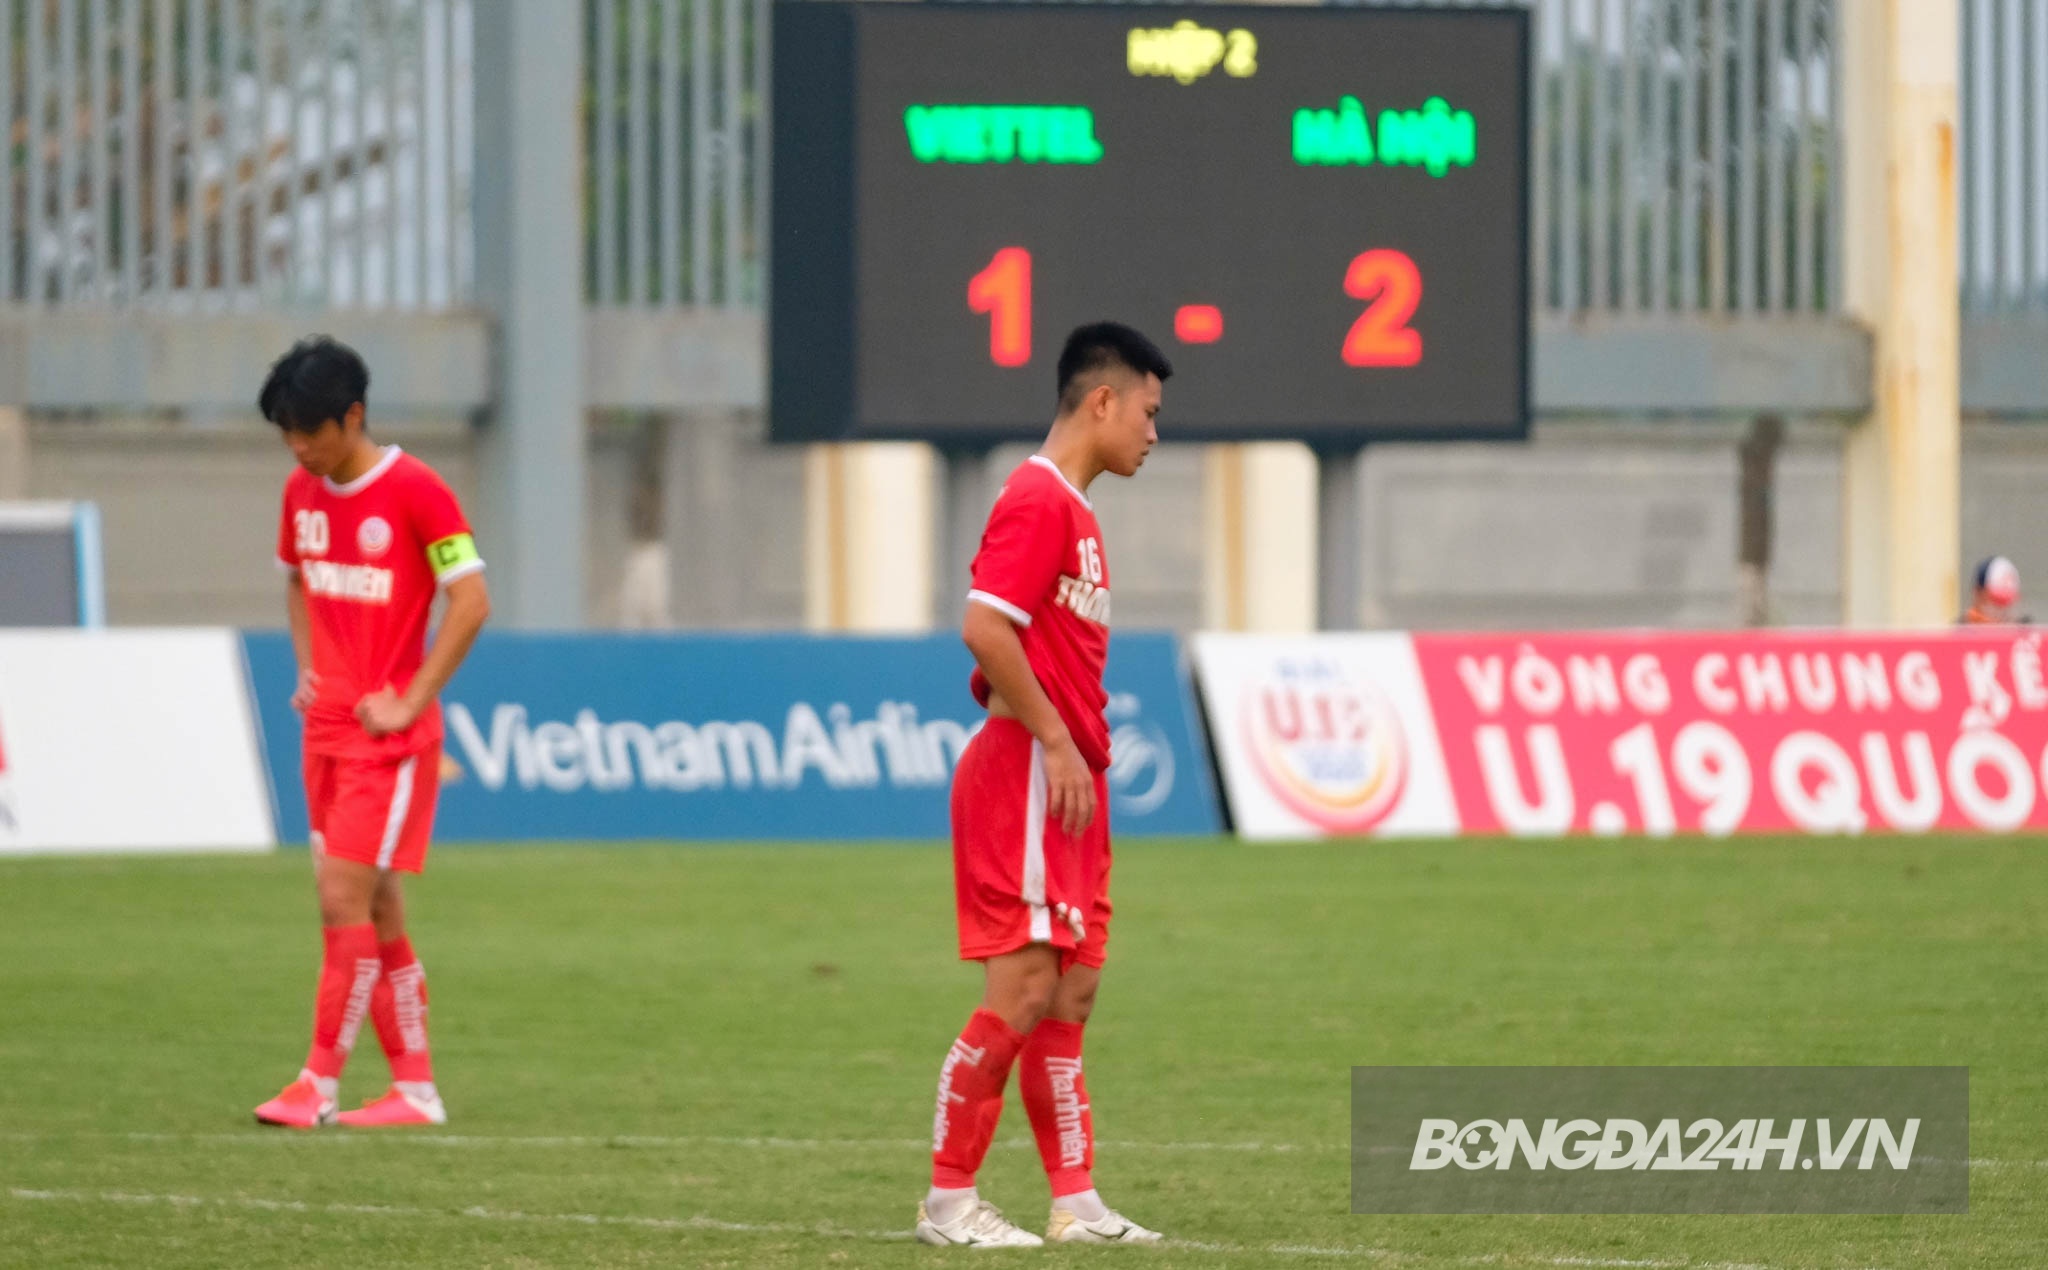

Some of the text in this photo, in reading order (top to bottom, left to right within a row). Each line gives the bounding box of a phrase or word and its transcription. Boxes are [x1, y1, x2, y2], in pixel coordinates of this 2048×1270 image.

[1224, 28, 1257, 77] 2
[904, 105, 1104, 164] VIETTEL
[1292, 95, 1476, 178] HÀ NỘI
[967, 247, 1032, 367] 1
[1341, 249, 1422, 367] 2
[295, 509, 329, 553] 30
[437, 540, 459, 566] C
[1077, 537, 1102, 583] 16
[1457, 641, 1671, 715] VÒNG
[1692, 652, 1942, 714] CHUNG
[1474, 684, 2048, 837] U.19 QUỐ
